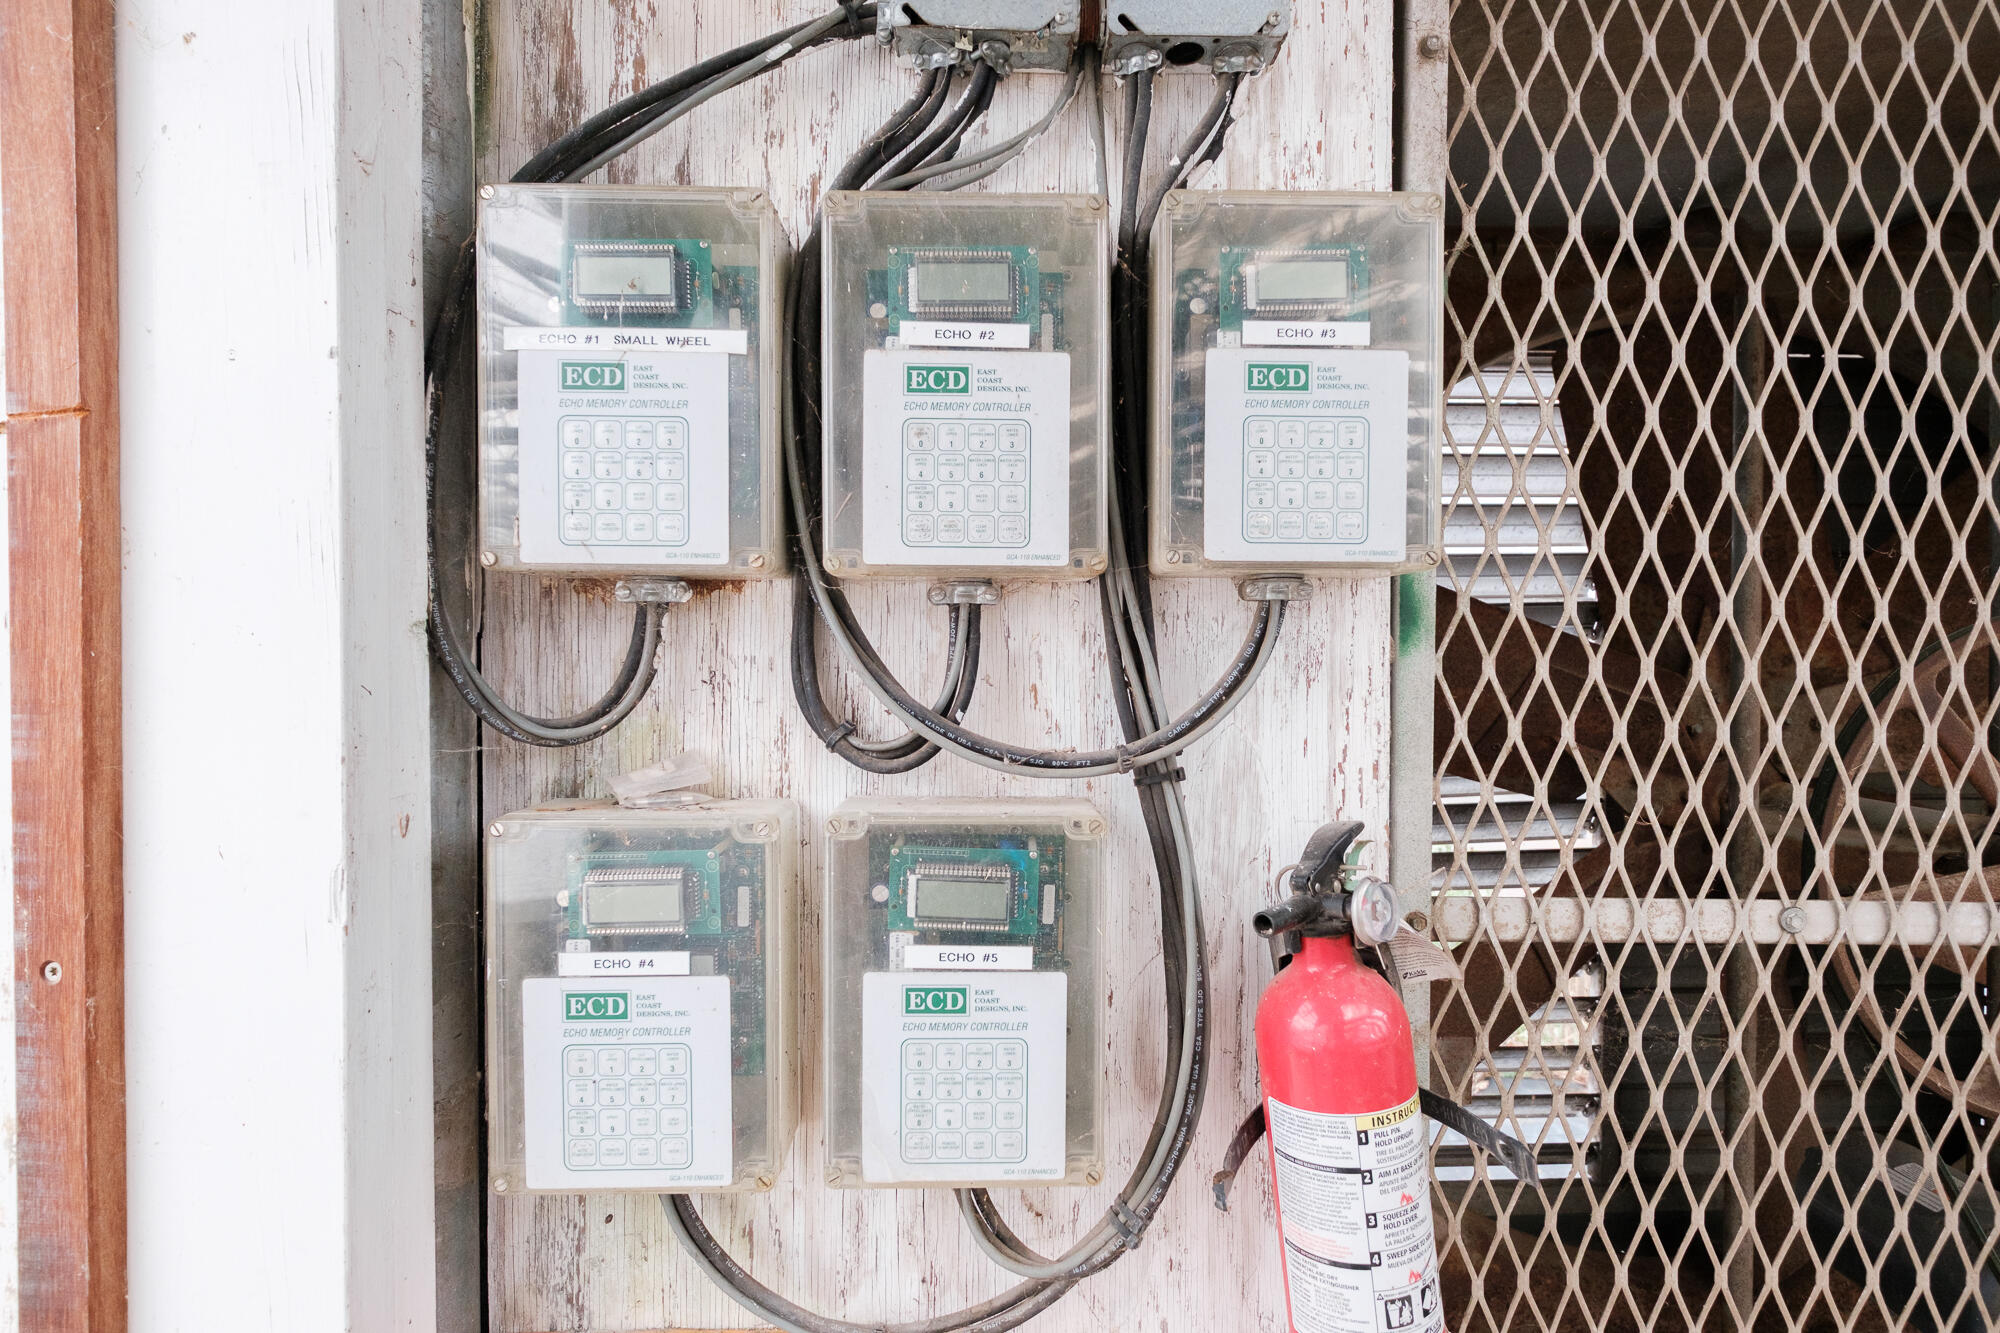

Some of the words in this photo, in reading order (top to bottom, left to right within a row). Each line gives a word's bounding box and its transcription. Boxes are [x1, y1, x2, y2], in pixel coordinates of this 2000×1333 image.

[539, 335, 577, 344] ECHO
[585, 336, 599, 344] #1
[614, 336, 658, 345] SMALL
[666, 336, 711, 346] WHEEL
[935, 330, 971, 339] ECHO
[980, 331, 994, 340] #2
[1277, 328, 1313, 338] ECHO
[1321, 329, 1336, 338] #3
[564, 366, 622, 386] ECD
[909, 370, 966, 390] ECD
[1250, 368, 1306, 387] ECD
[559, 399, 584, 408] ECHO
[585, 399, 626, 408] MEMORY
[629, 399, 688, 409] CONTROLLER
[904, 402, 928, 410] ECHO
[931, 402, 970, 411] MEMORY
[972, 403, 1031, 411] CONTROLLER
[1245, 400, 1268, 408] ECHO
[1271, 400, 1310, 409] MEMORY
[1312, 400, 1370, 409] CONTROLLER
[1209, 688, 1225, 704] TYPE
[1224, 663, 1244, 688] SJOW-A
[1244, 643, 1256, 657] (UL)
[925, 720, 945, 733] MADE
[957, 737, 972, 747] USA
[594, 959, 630, 969] ECHO
[639, 959, 654, 968] #4
[939, 953, 975, 962] ECHO
[983, 953, 998, 962] #5
[568, 997, 625, 1016] ECD
[908, 991, 964, 1010] ECD
[563, 1028, 587, 1037] ECHO
[590, 1028, 630, 1037] MEMORY
[632, 1027, 691, 1036] CONTROLLER
[902, 1023, 926, 1031] ECHO
[929, 1023, 968, 1031] MEMORY
[971, 1022, 1028, 1031] CONTROLLER
[1190, 1082, 1197, 1091] IN
[1186, 1093, 1195, 1116] MADE
[1360, 1133, 1365, 1143] 1
[1374, 1130, 1390, 1138] PULL
[1375, 1139, 1392, 1147] HOLD
[1394, 1129, 1414, 1143] UPRIGHT
[1364, 1173, 1371, 1183] 2
[1401, 1162, 1412, 1172] BASE
[1368, 1215, 1375, 1226] 3
[1383, 1209, 1409, 1221] SQUEEZE
[1410, 1202, 1420, 1213] AND
[1384, 1221, 1401, 1230] HOLD
[1403, 1213, 1418, 1225] LEVER
[1372, 1254, 1379, 1264] 4
[1387, 1249, 1407, 1260] SWEEP
[1409, 1244, 1420, 1252] SIDE
